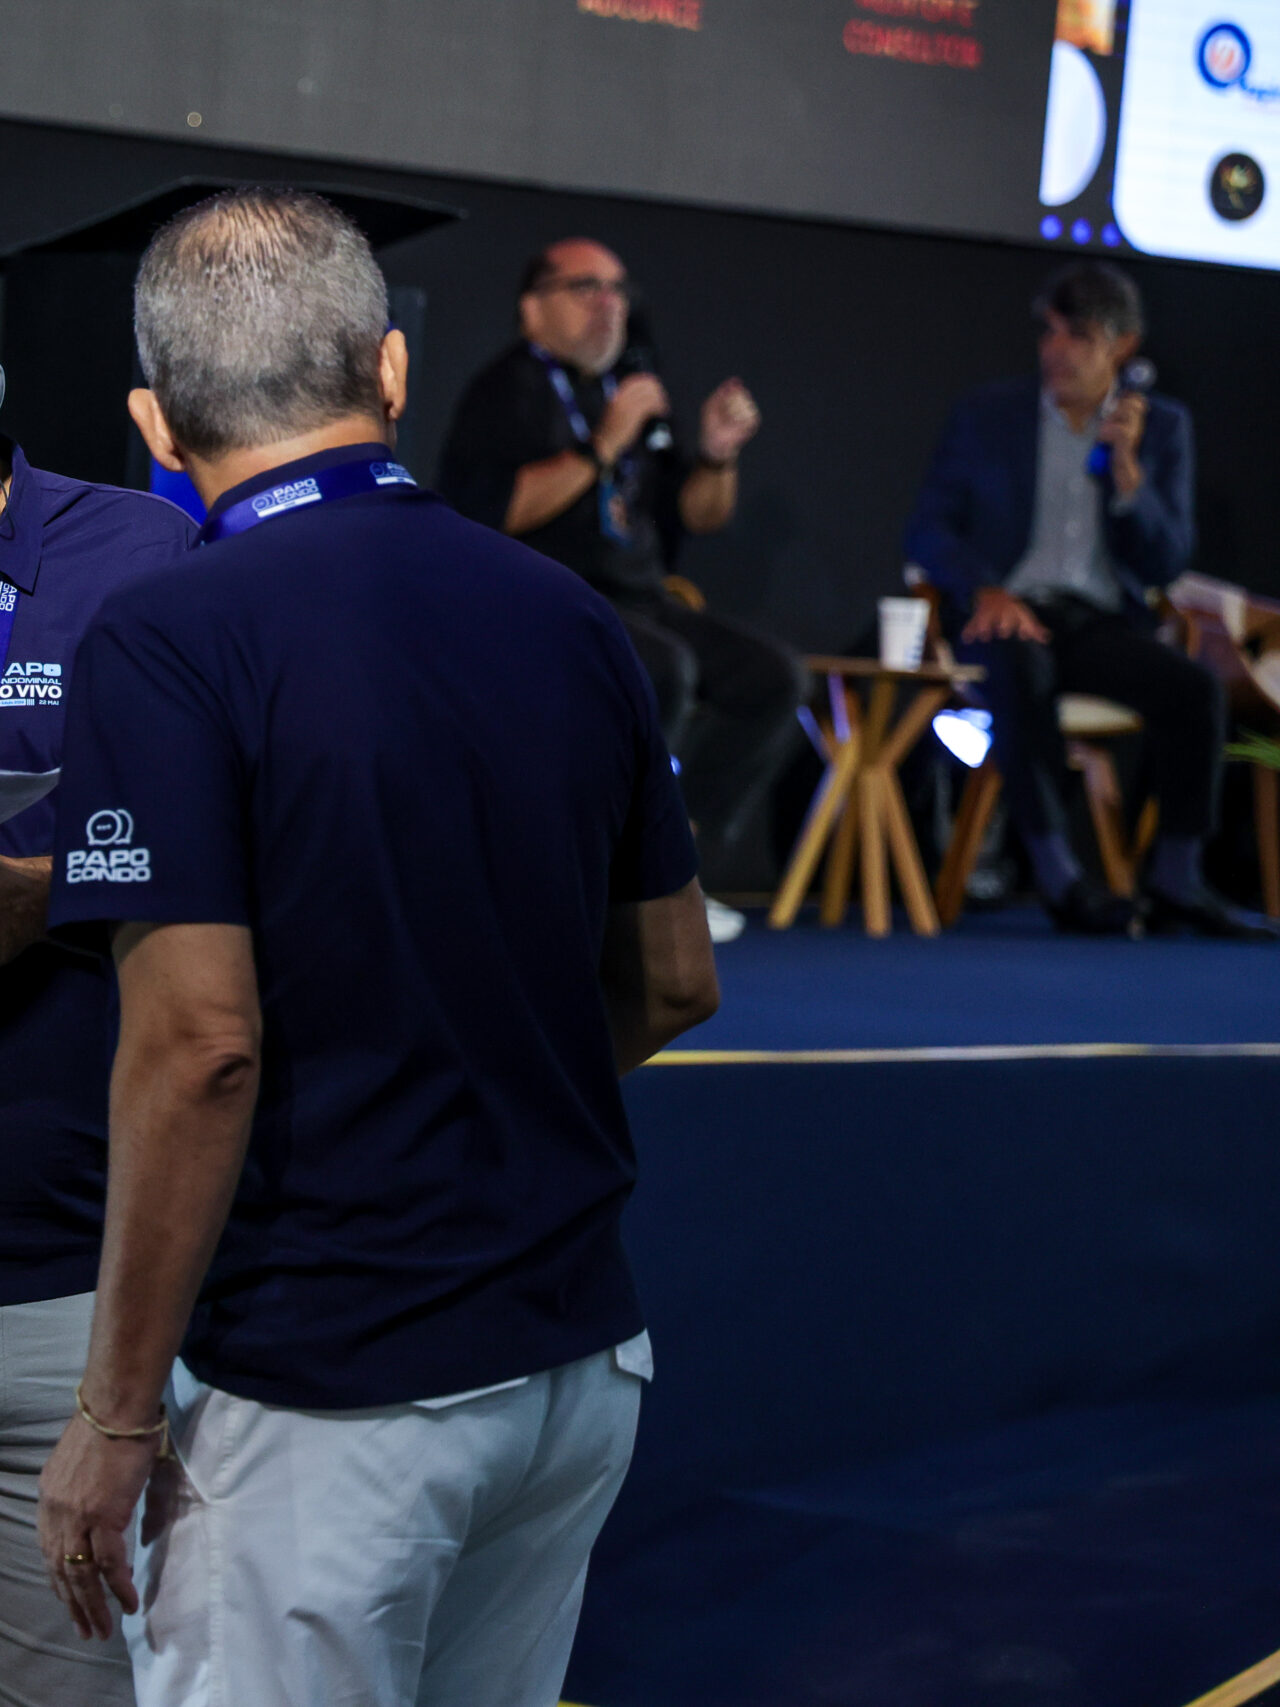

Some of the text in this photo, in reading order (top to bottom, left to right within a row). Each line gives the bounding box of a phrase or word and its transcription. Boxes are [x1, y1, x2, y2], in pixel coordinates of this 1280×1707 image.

[273, 478, 316, 498] PAPO
[5, 585, 18, 612] APO
[4, 662, 62, 677] APO
[0, 677, 62, 685] NDOMINIAL
[15, 684, 62, 699] VIVO
[67, 848, 150, 869] PAPO
[67, 866, 151, 884] CONDO
